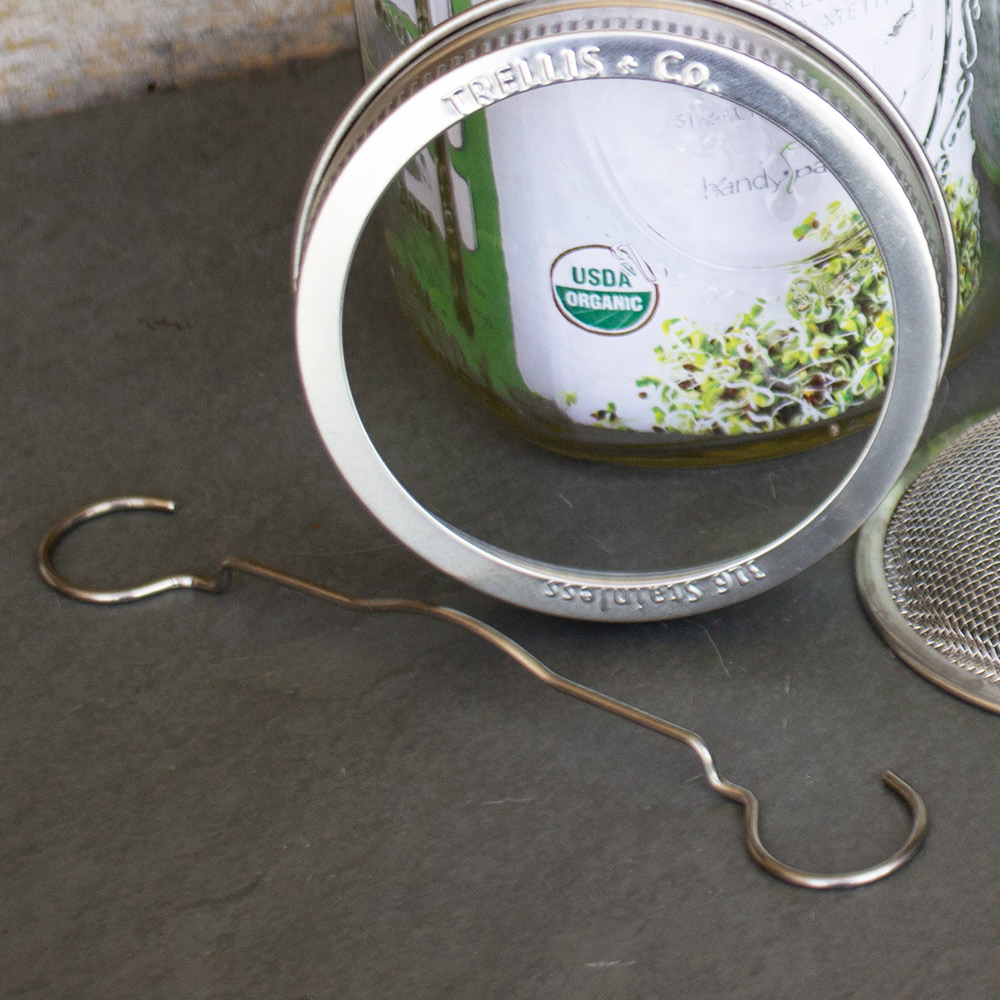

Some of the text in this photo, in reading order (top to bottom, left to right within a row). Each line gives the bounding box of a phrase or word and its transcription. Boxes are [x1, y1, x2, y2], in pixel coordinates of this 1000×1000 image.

[441, 46, 604, 115] TRELLIS
[654, 49, 720, 93] Co.
[571, 265, 633, 288] USDA
[565, 290, 643, 313] ORGANIC
